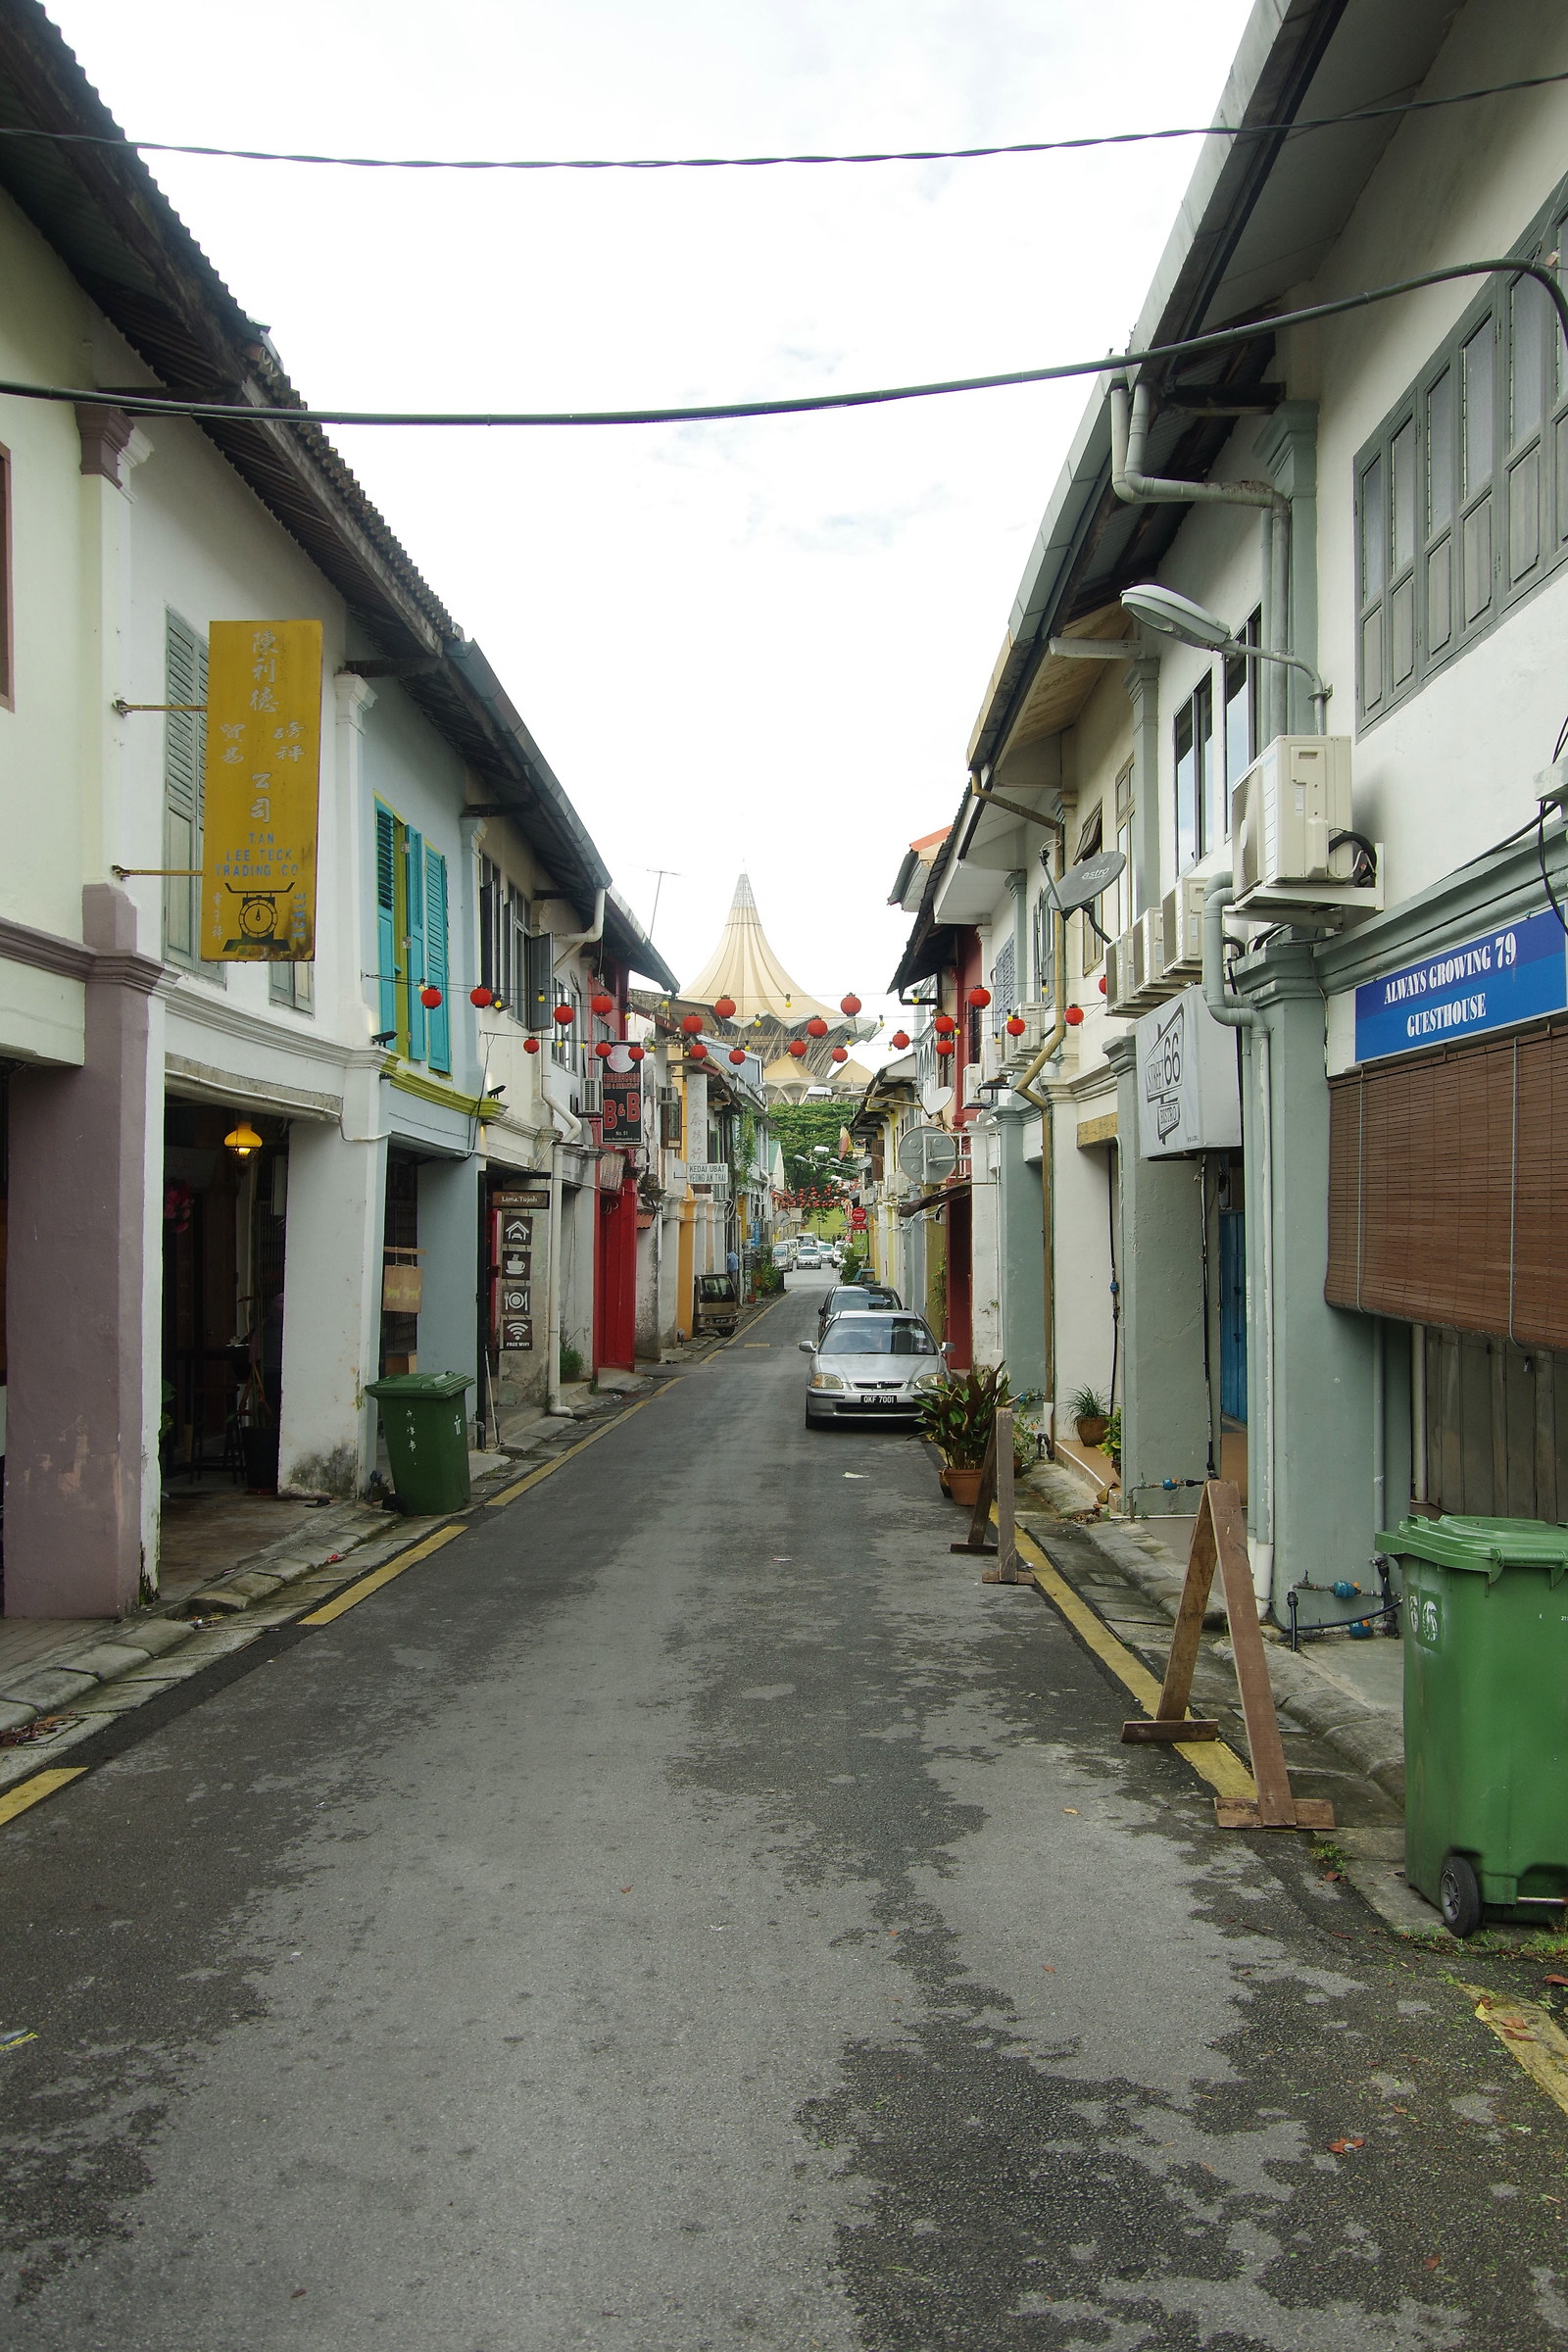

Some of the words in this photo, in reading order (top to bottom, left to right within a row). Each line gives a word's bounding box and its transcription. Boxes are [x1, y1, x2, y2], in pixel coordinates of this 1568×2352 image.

[250, 629, 279, 713] 陳利德
[250, 771, 272, 823] 公司
[226, 850, 250, 861] LEE
[260, 849, 292, 861] TECK
[249, 833, 274, 844] TAN
[215, 864, 271, 876] TRADING
[1081, 867, 1110, 879] astro
[292, 893, 306, 939] SCALE
[1384, 968, 1427, 1004] ALWAYS
[1429, 945, 1492, 990] GROWING
[1494, 932, 1517, 969] 79
[1406, 993, 1487, 1037] GUESTHOUSE
[1164, 1032, 1181, 1086] 66
[603, 1092, 640, 1130] B&B
[1159, 1105, 1176, 1125] BISTRO
[1409, 1593, 1438, 1642] 66
